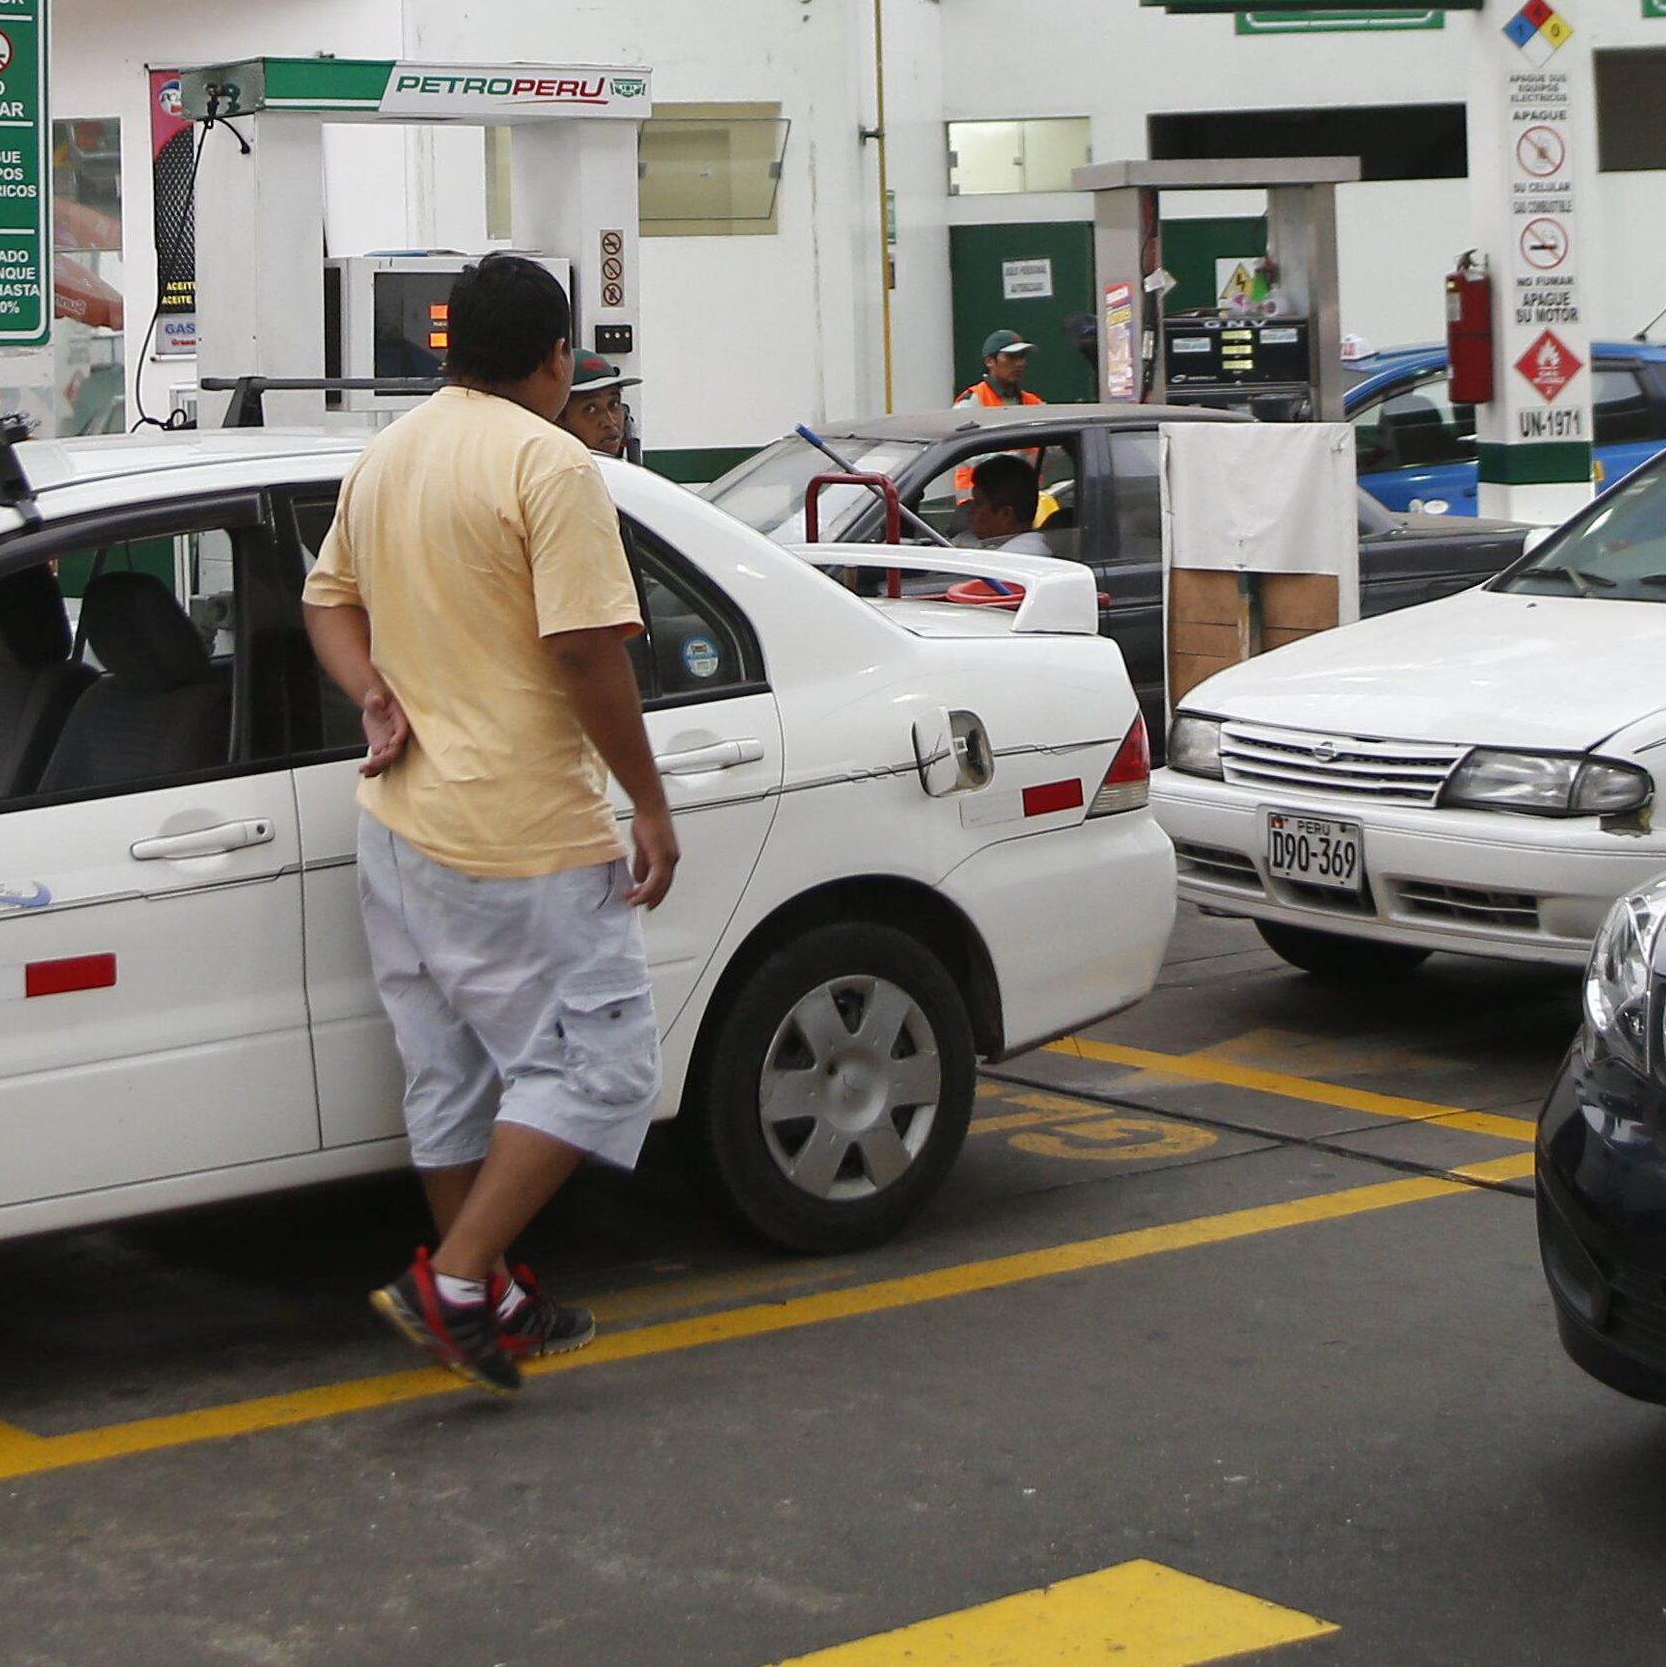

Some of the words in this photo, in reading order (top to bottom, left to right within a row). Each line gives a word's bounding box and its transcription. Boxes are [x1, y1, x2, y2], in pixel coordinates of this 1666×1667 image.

[396, 76, 605, 97] PETROPERU
[1513, 110, 1567, 121] APAGUE
[1522, 292, 1570, 307] APAGUE
[1516, 308, 1532, 323] SU
[1536, 307, 1579, 322] MOTOR
[1519, 409, 1581, 438] UN-1971
[1297, 820, 1331, 836] PERU
[1273, 831, 1355, 878] D90-369
